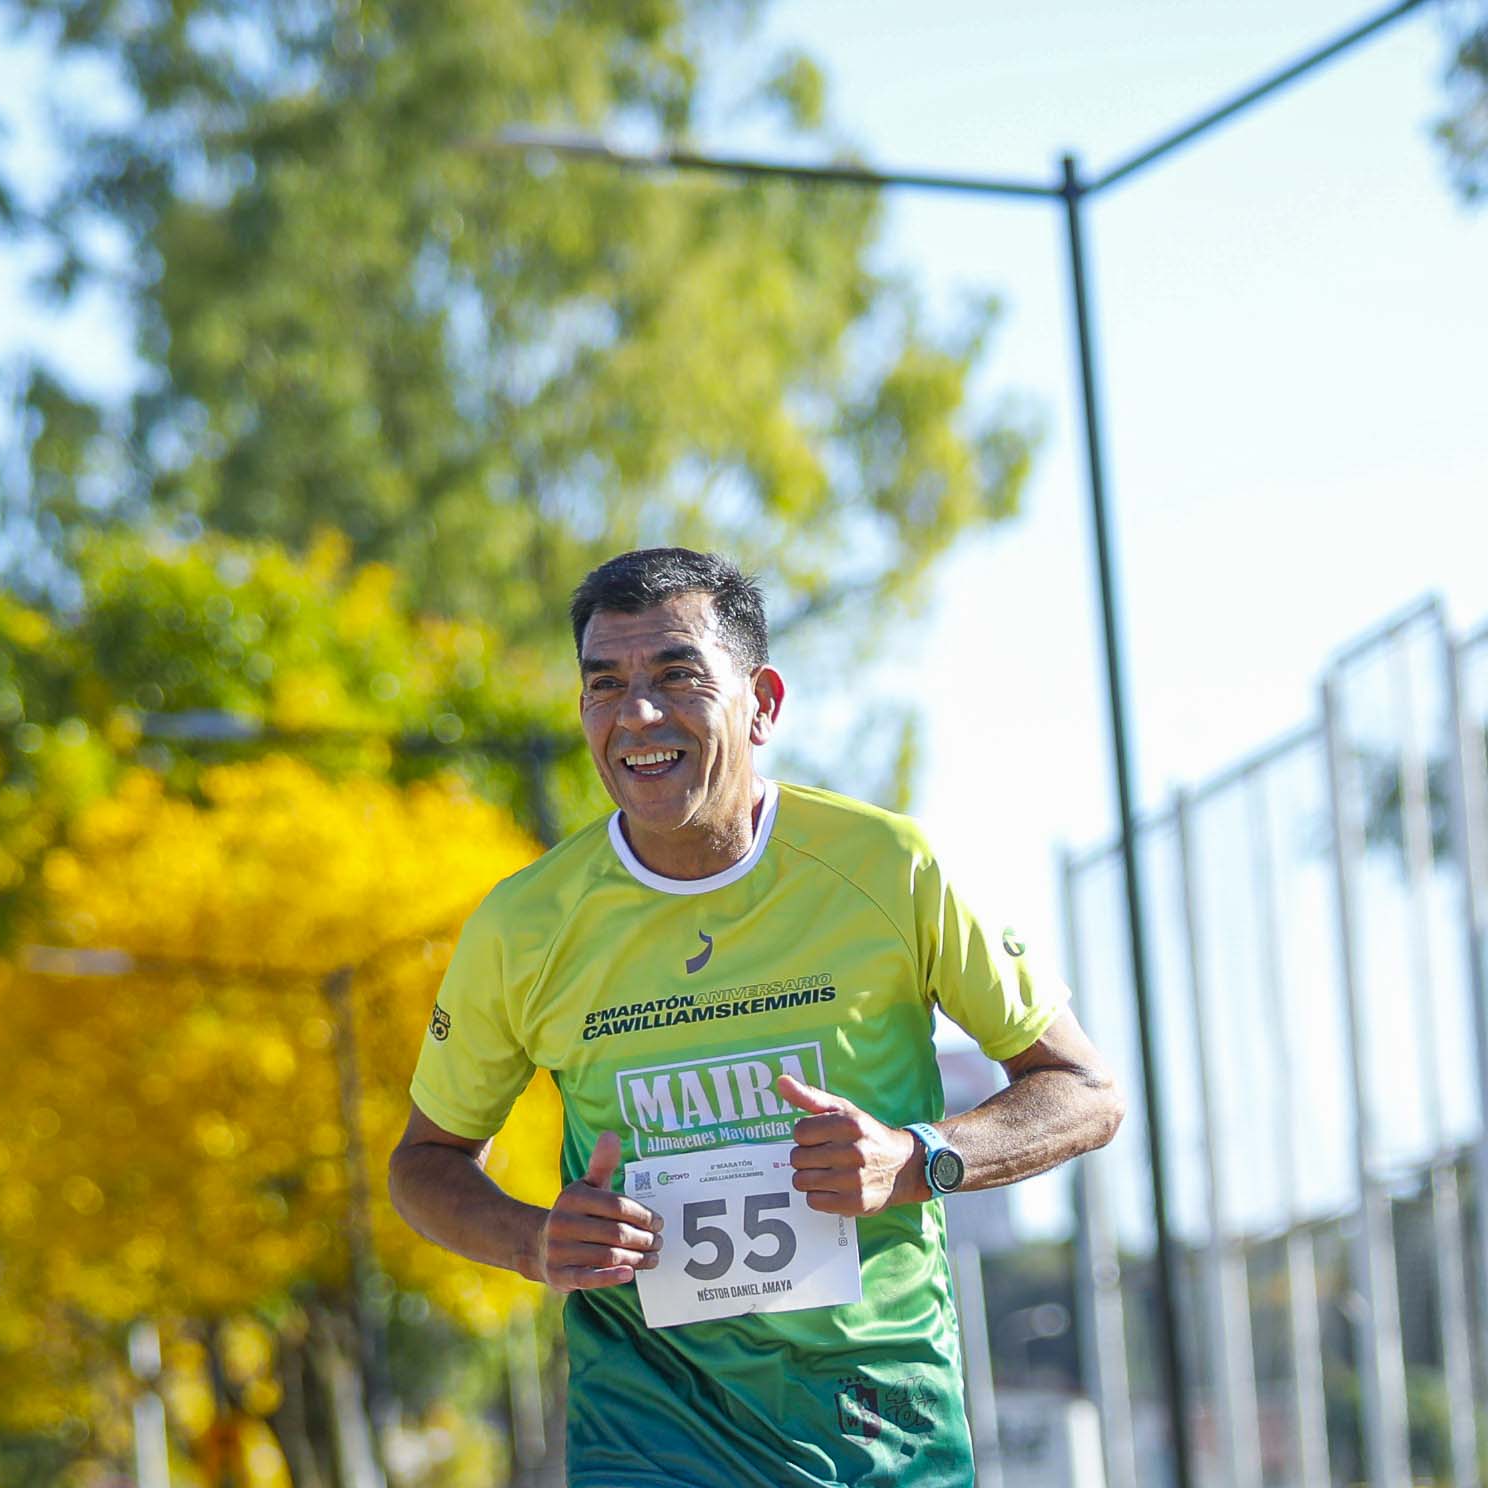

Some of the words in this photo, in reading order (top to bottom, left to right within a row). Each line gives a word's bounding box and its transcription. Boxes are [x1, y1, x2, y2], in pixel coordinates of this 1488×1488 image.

[583, 986, 836, 1040] CAWILLIAMSKEMMIS
[647, 1130, 716, 1153] Almacenes
[719, 1120, 791, 1143] Mayoristas
[683, 1192, 797, 1280] 55
[697, 1287, 730, 1302] NÉSTOR
[730, 1283, 760, 1298] DANIEL
[762, 1279, 792, 1294] AMAYA
